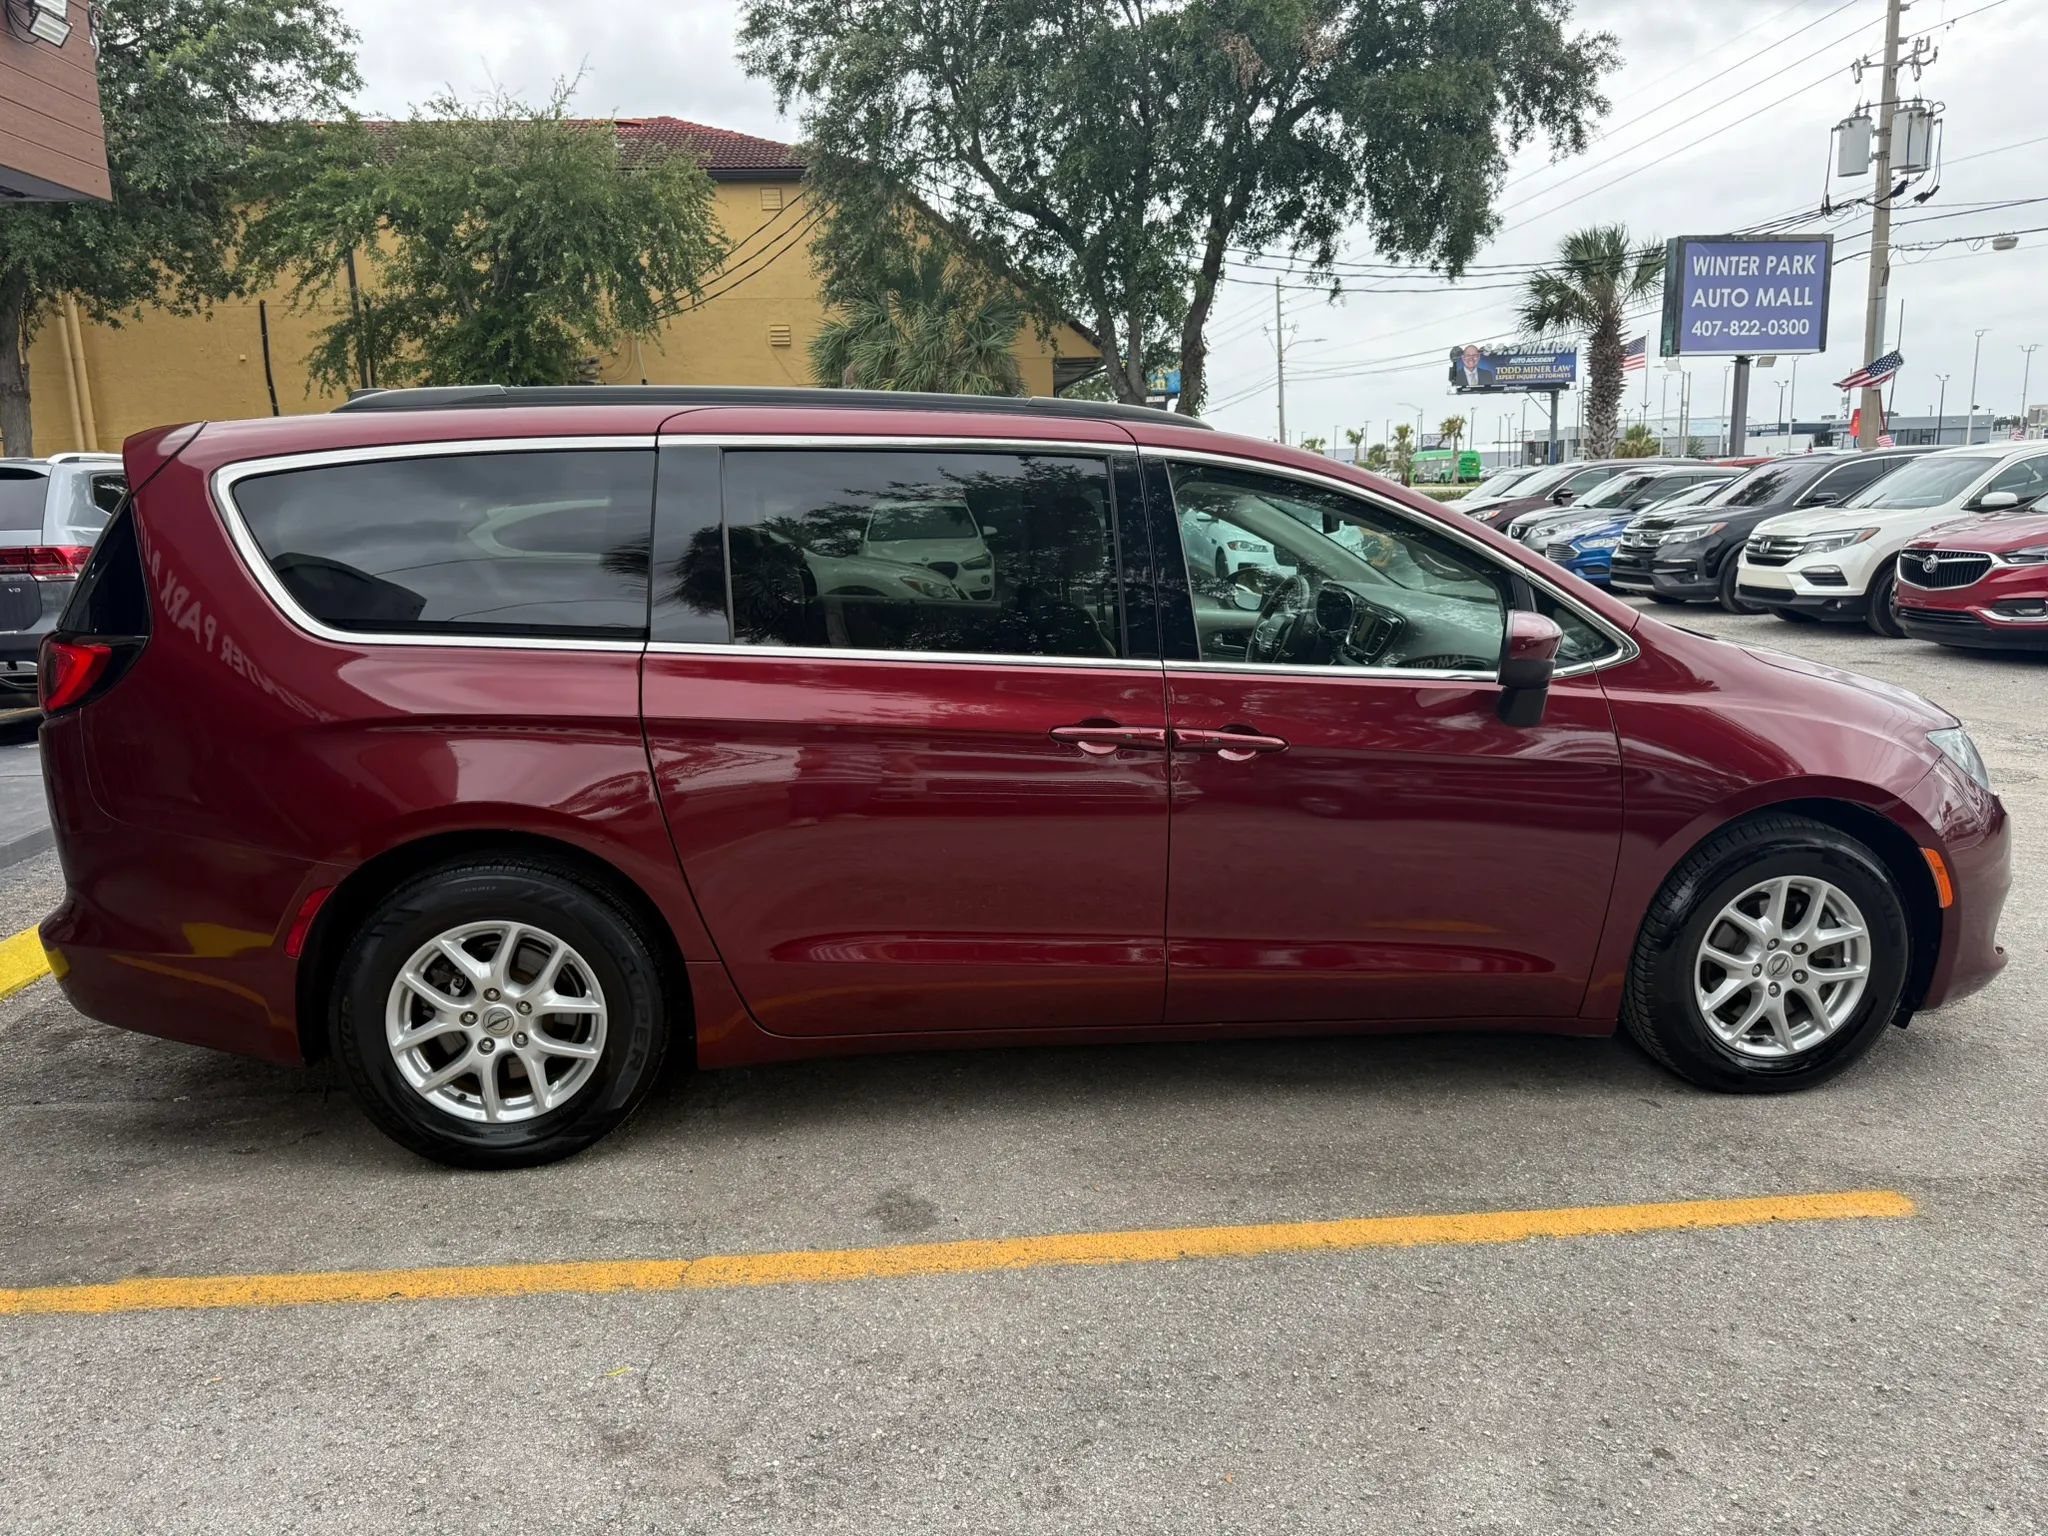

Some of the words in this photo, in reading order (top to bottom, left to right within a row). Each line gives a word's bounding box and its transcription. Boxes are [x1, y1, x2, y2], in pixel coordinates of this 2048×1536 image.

[1692, 255, 1760, 277] WINTER
[1765, 254, 1817, 276] PARK
[1691, 287, 1749, 308] AUTO
[1755, 286, 1813, 307] MALL
[1691, 319, 1810, 336] 407-822-0300
[1519, 340, 1578, 355] MILLION
[1526, 356, 1556, 364] ACCIDENT
[1496, 366, 1521, 375] TODD
[1523, 365, 1551, 374] MINER
[1552, 364, 1571, 373] LAW
